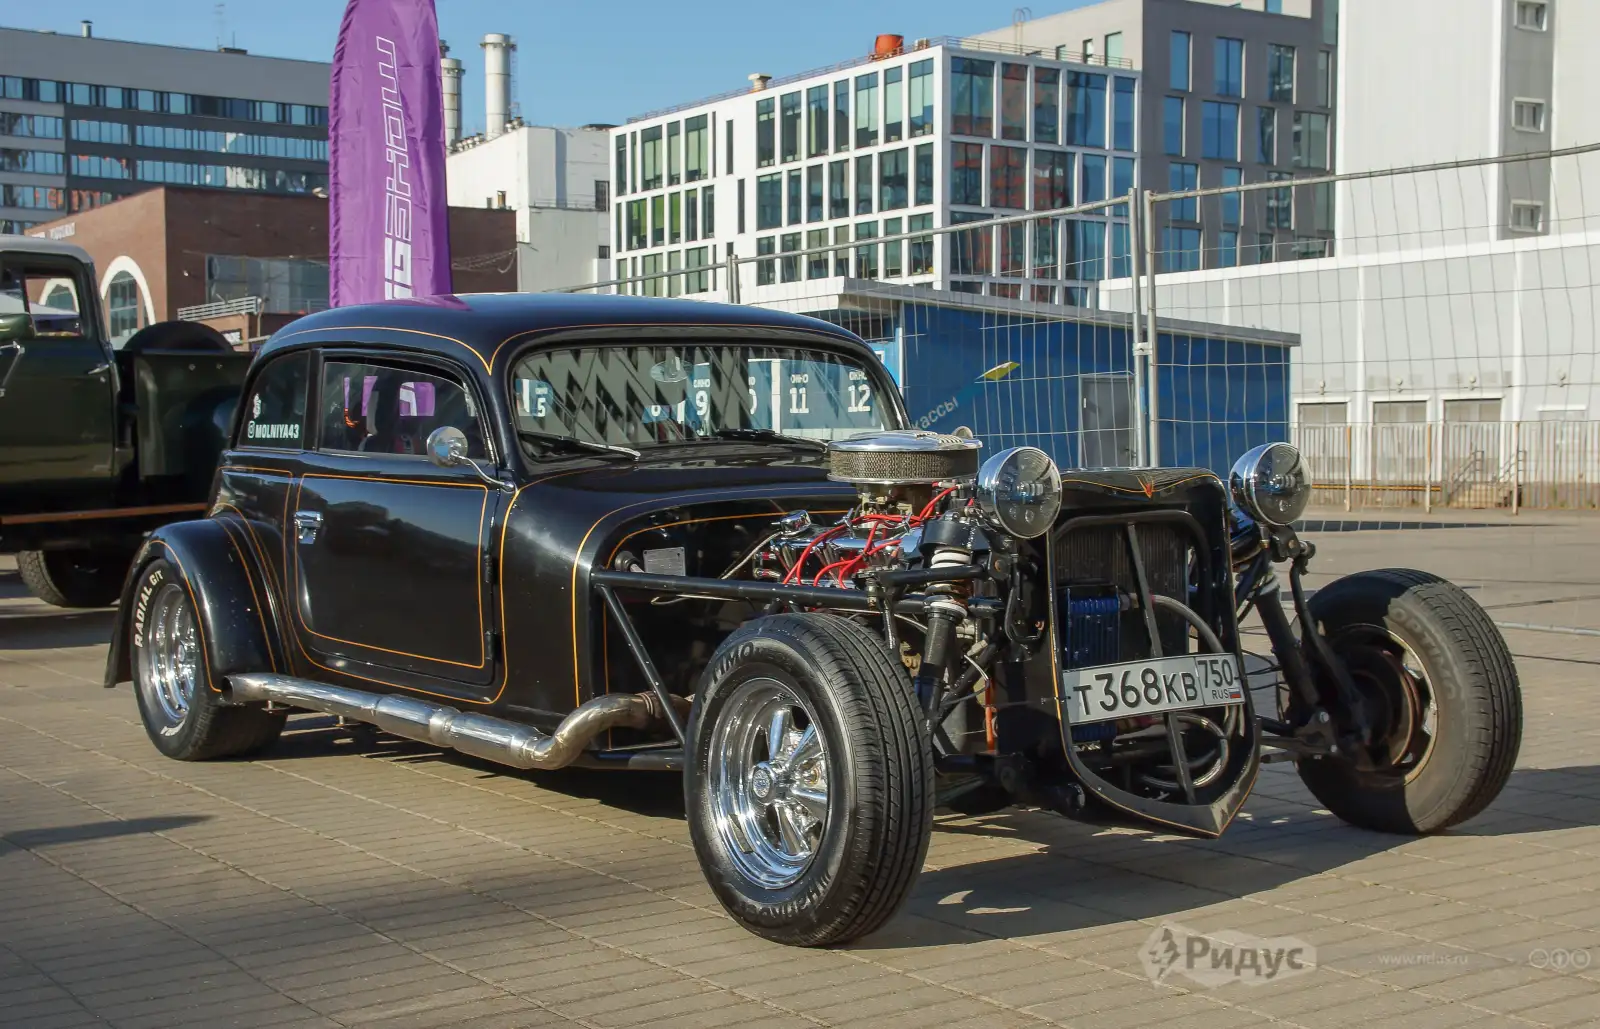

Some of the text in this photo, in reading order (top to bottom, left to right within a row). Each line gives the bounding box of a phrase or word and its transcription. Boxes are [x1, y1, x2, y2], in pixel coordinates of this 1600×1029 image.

[537, 397, 546, 417] 5
[695, 390, 708, 416] 9
[789, 387, 809, 413] 11
[847, 384, 871, 412] 12
[134, 586, 153, 648] RADIAL
[1198, 658, 1234, 688] 750
[1212, 688, 1230, 700] RUS
